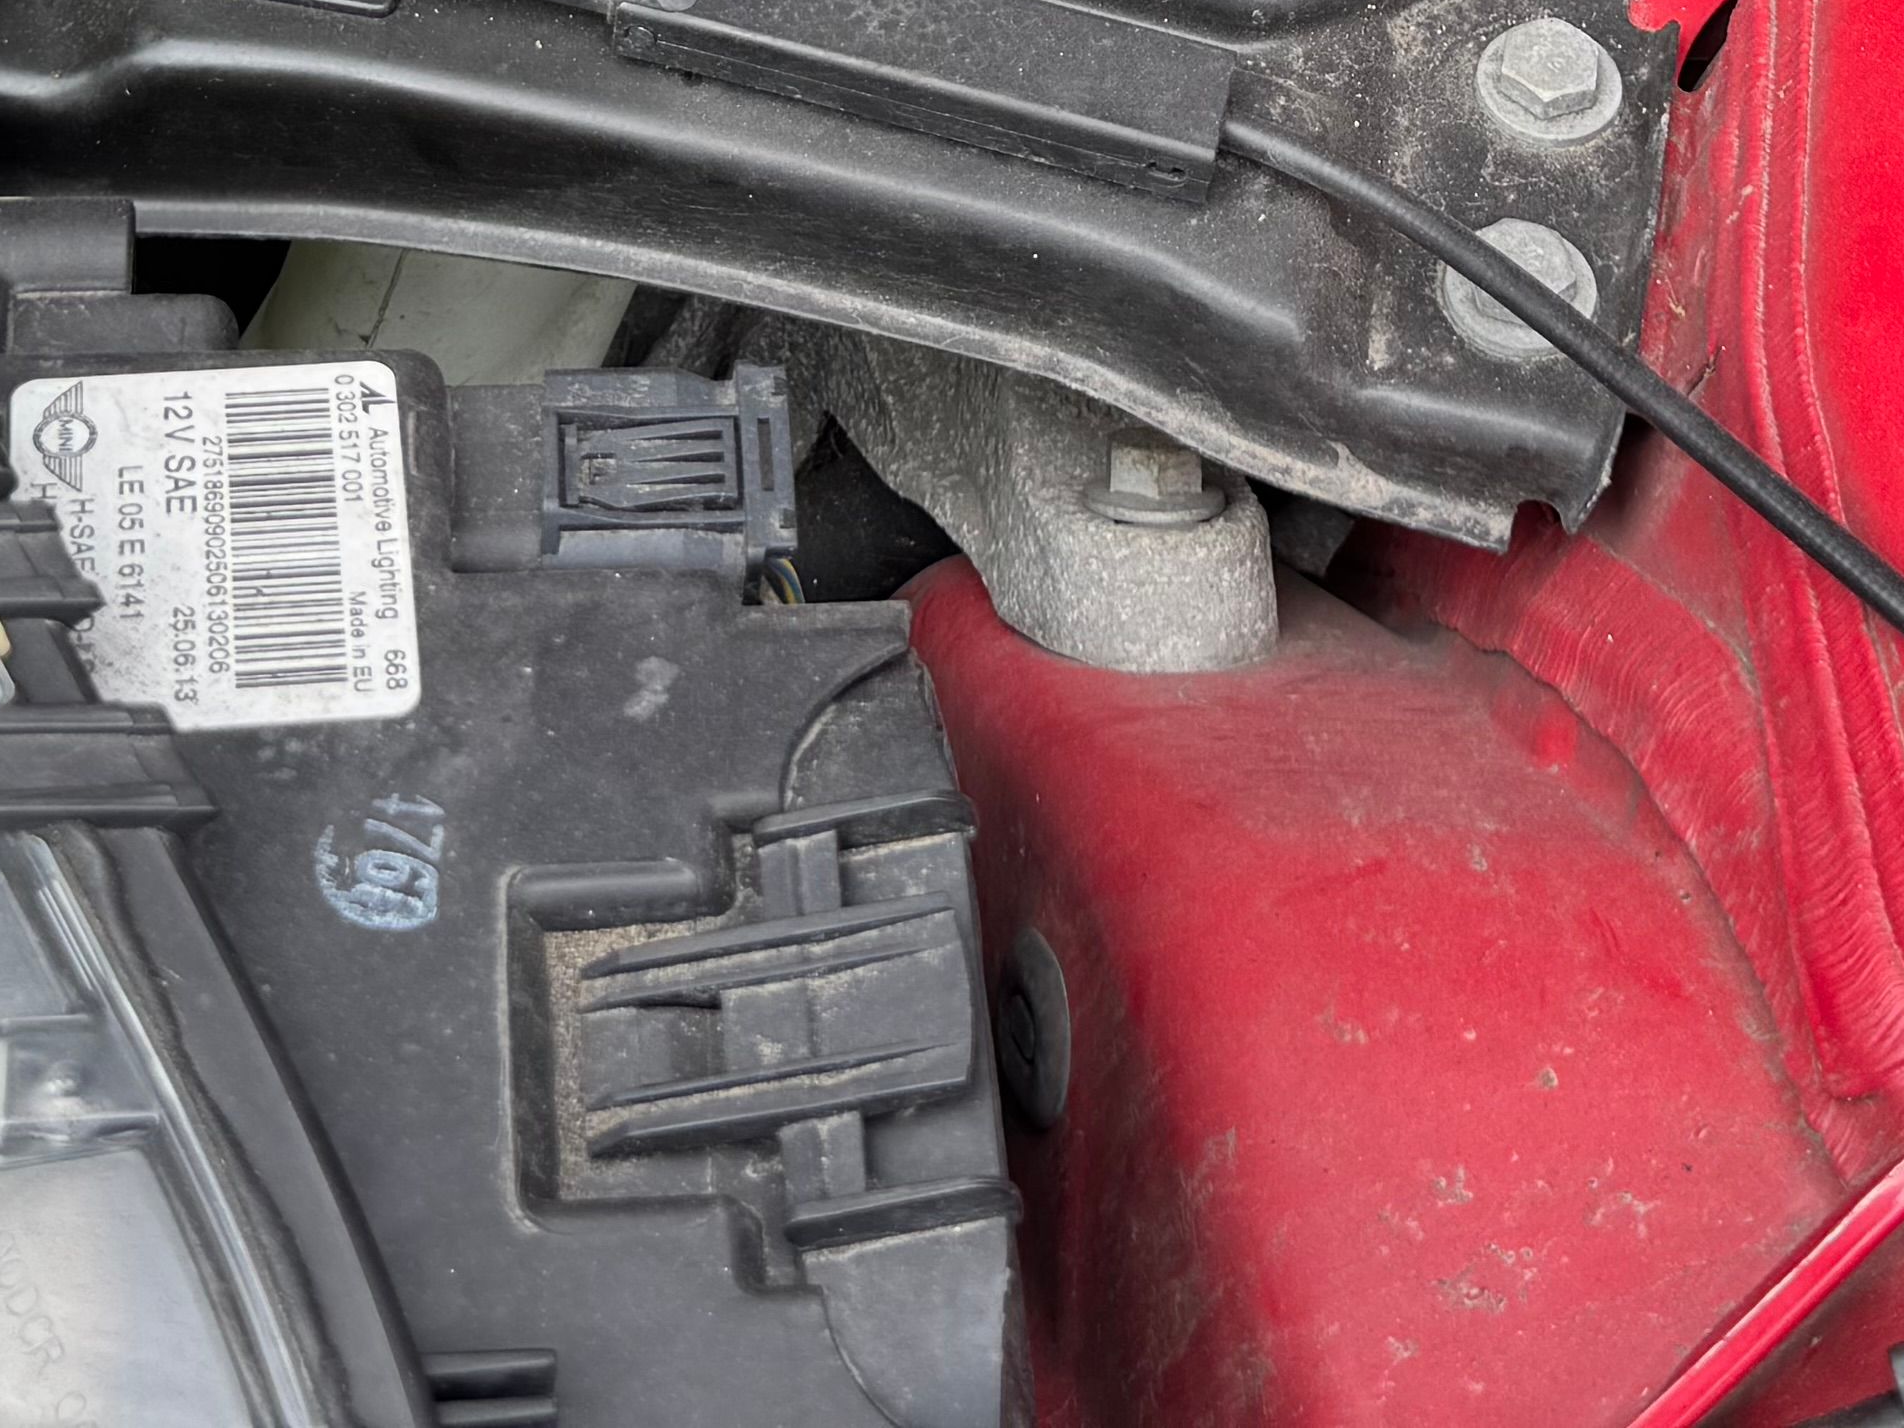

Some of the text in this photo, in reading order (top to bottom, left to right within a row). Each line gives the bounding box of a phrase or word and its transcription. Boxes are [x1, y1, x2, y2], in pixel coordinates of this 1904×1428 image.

[56, 418, 74, 453] MINI
[366, 426, 391, 533] Automotive
[162, 453, 197, 515] SAE
[116, 465, 146, 620] LE 05 E 6141
[333, 373, 372, 692] 0 302 517 001 Made in EU
[370, 538, 399, 620] Lighting
[167, 605, 200, 704] 25.06.13
[383, 648, 405, 690] 668
